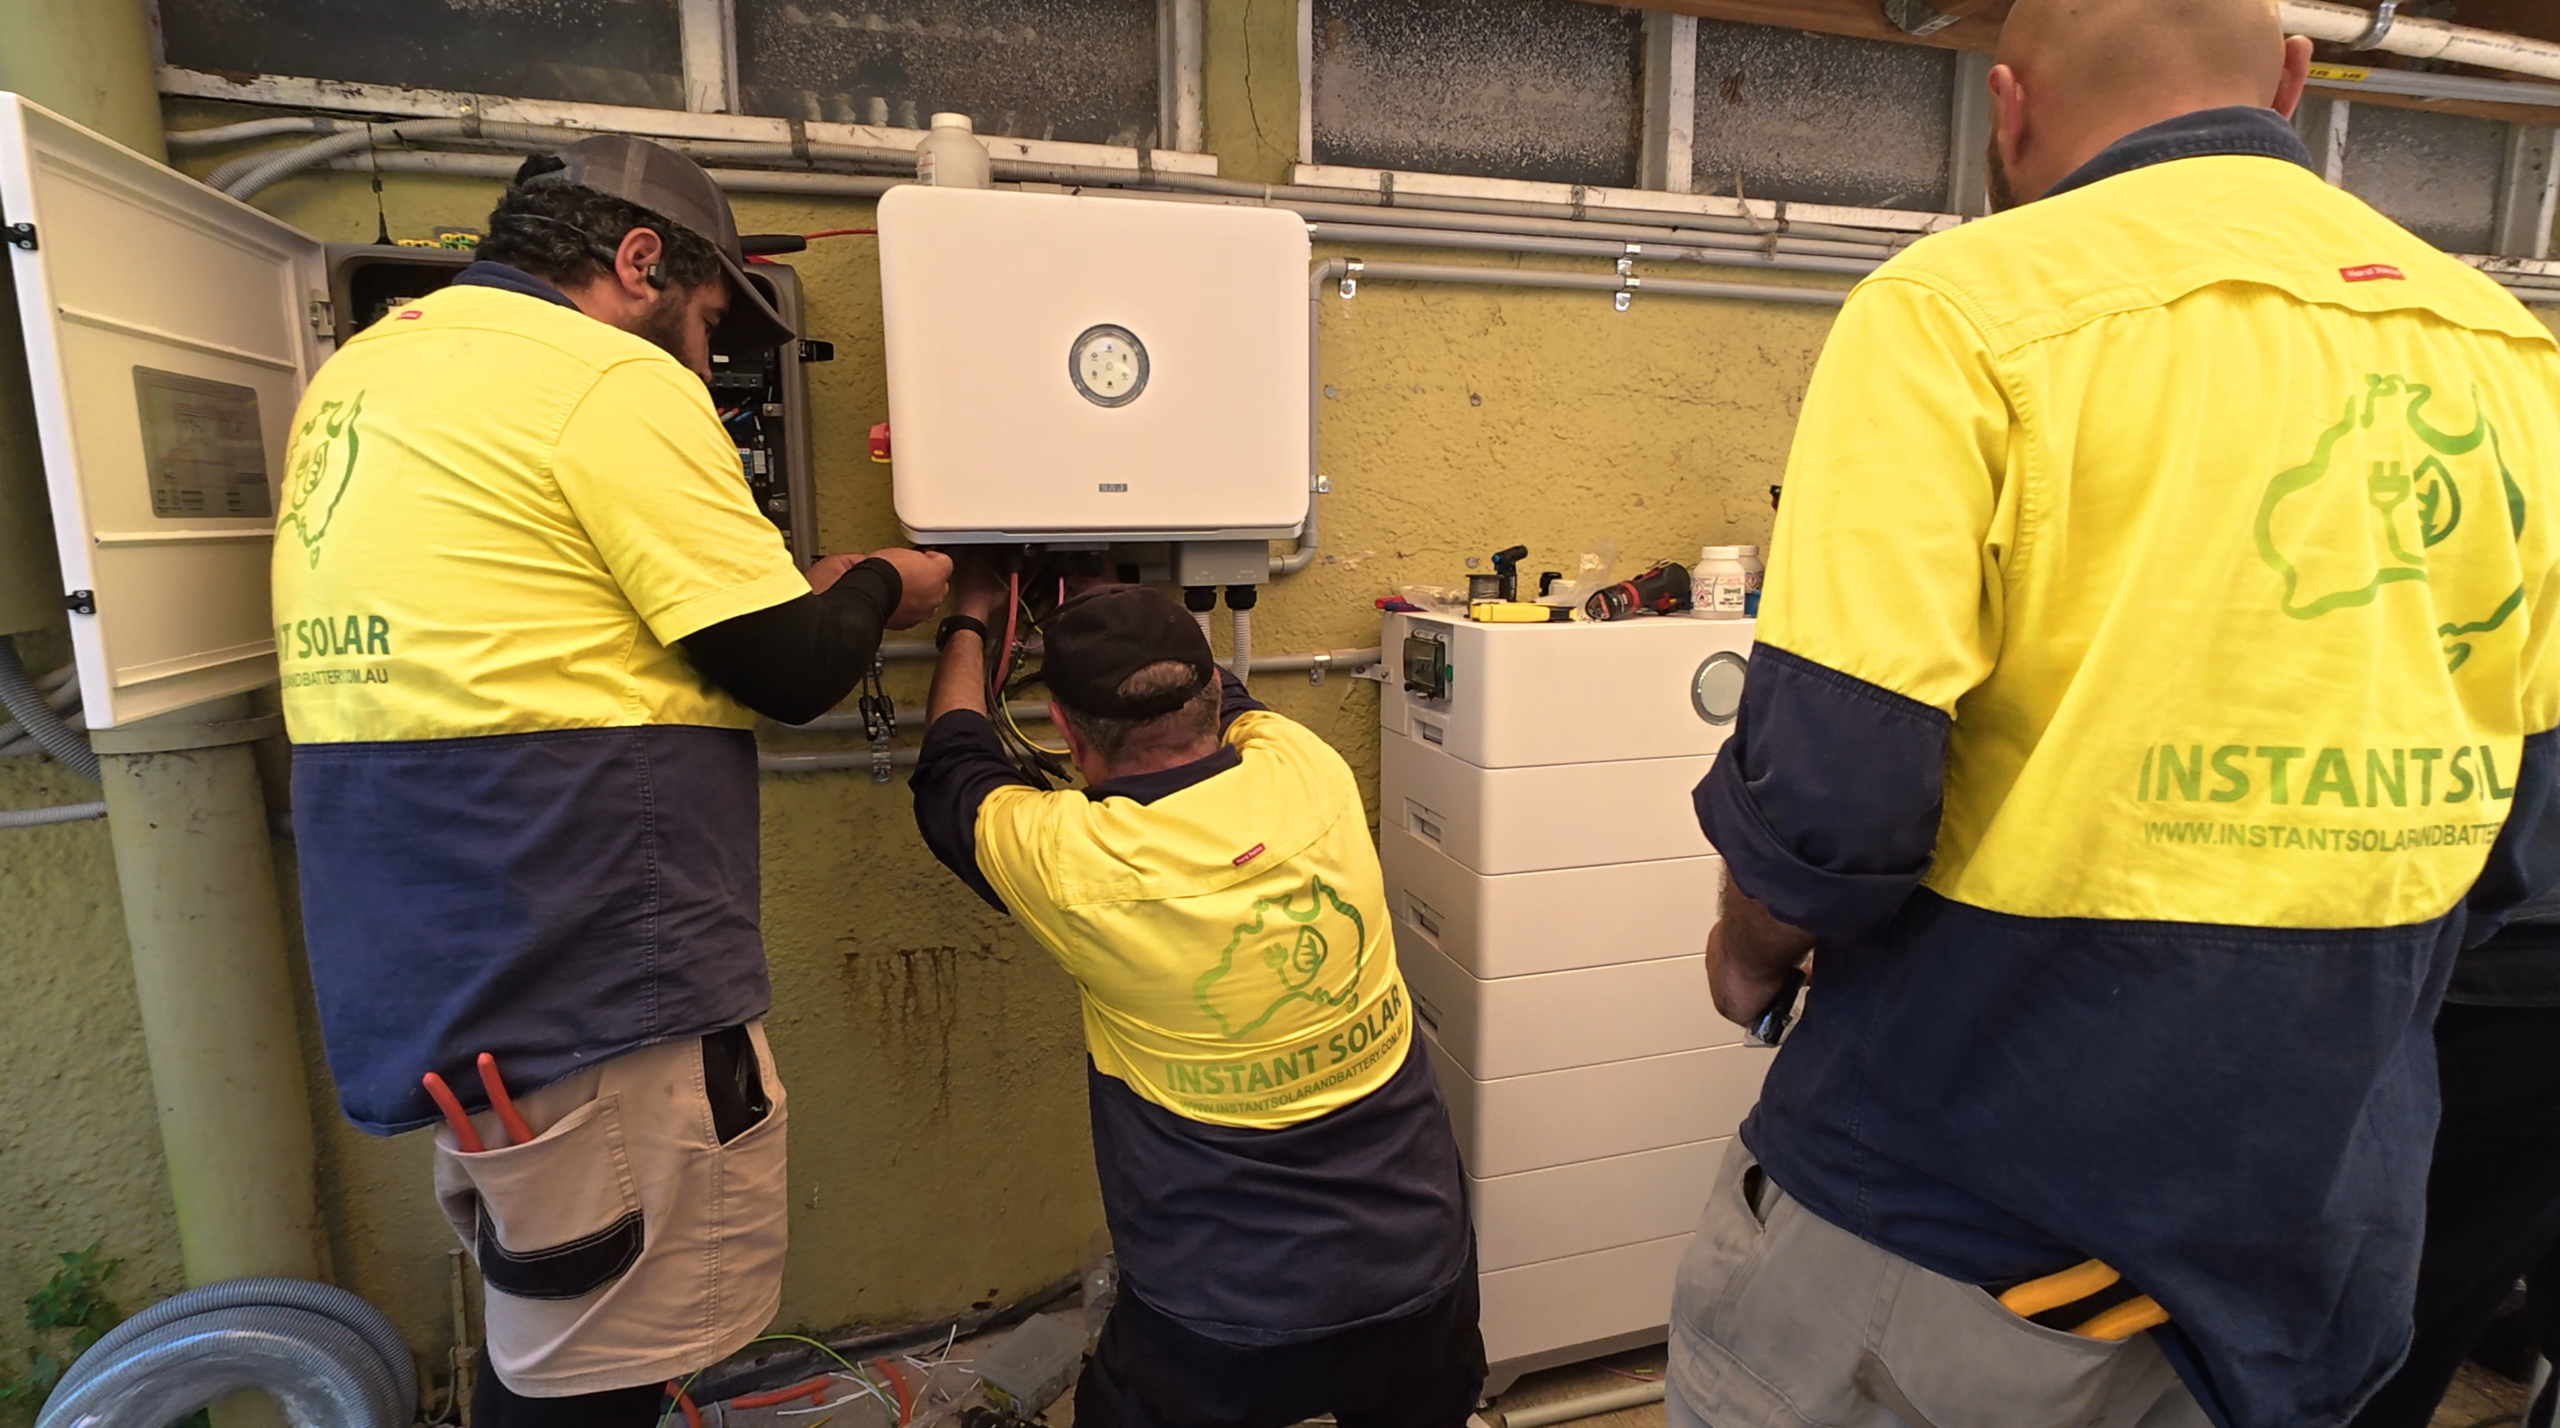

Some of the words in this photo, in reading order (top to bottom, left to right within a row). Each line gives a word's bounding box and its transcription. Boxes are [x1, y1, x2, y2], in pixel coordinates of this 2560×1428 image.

[297, 615, 390, 659] SOLAR
[2137, 743, 2443, 807] INSTANT
[1165, 1044, 1319, 1095] INSTANT
[1329, 984, 1402, 1065] SOLAR
